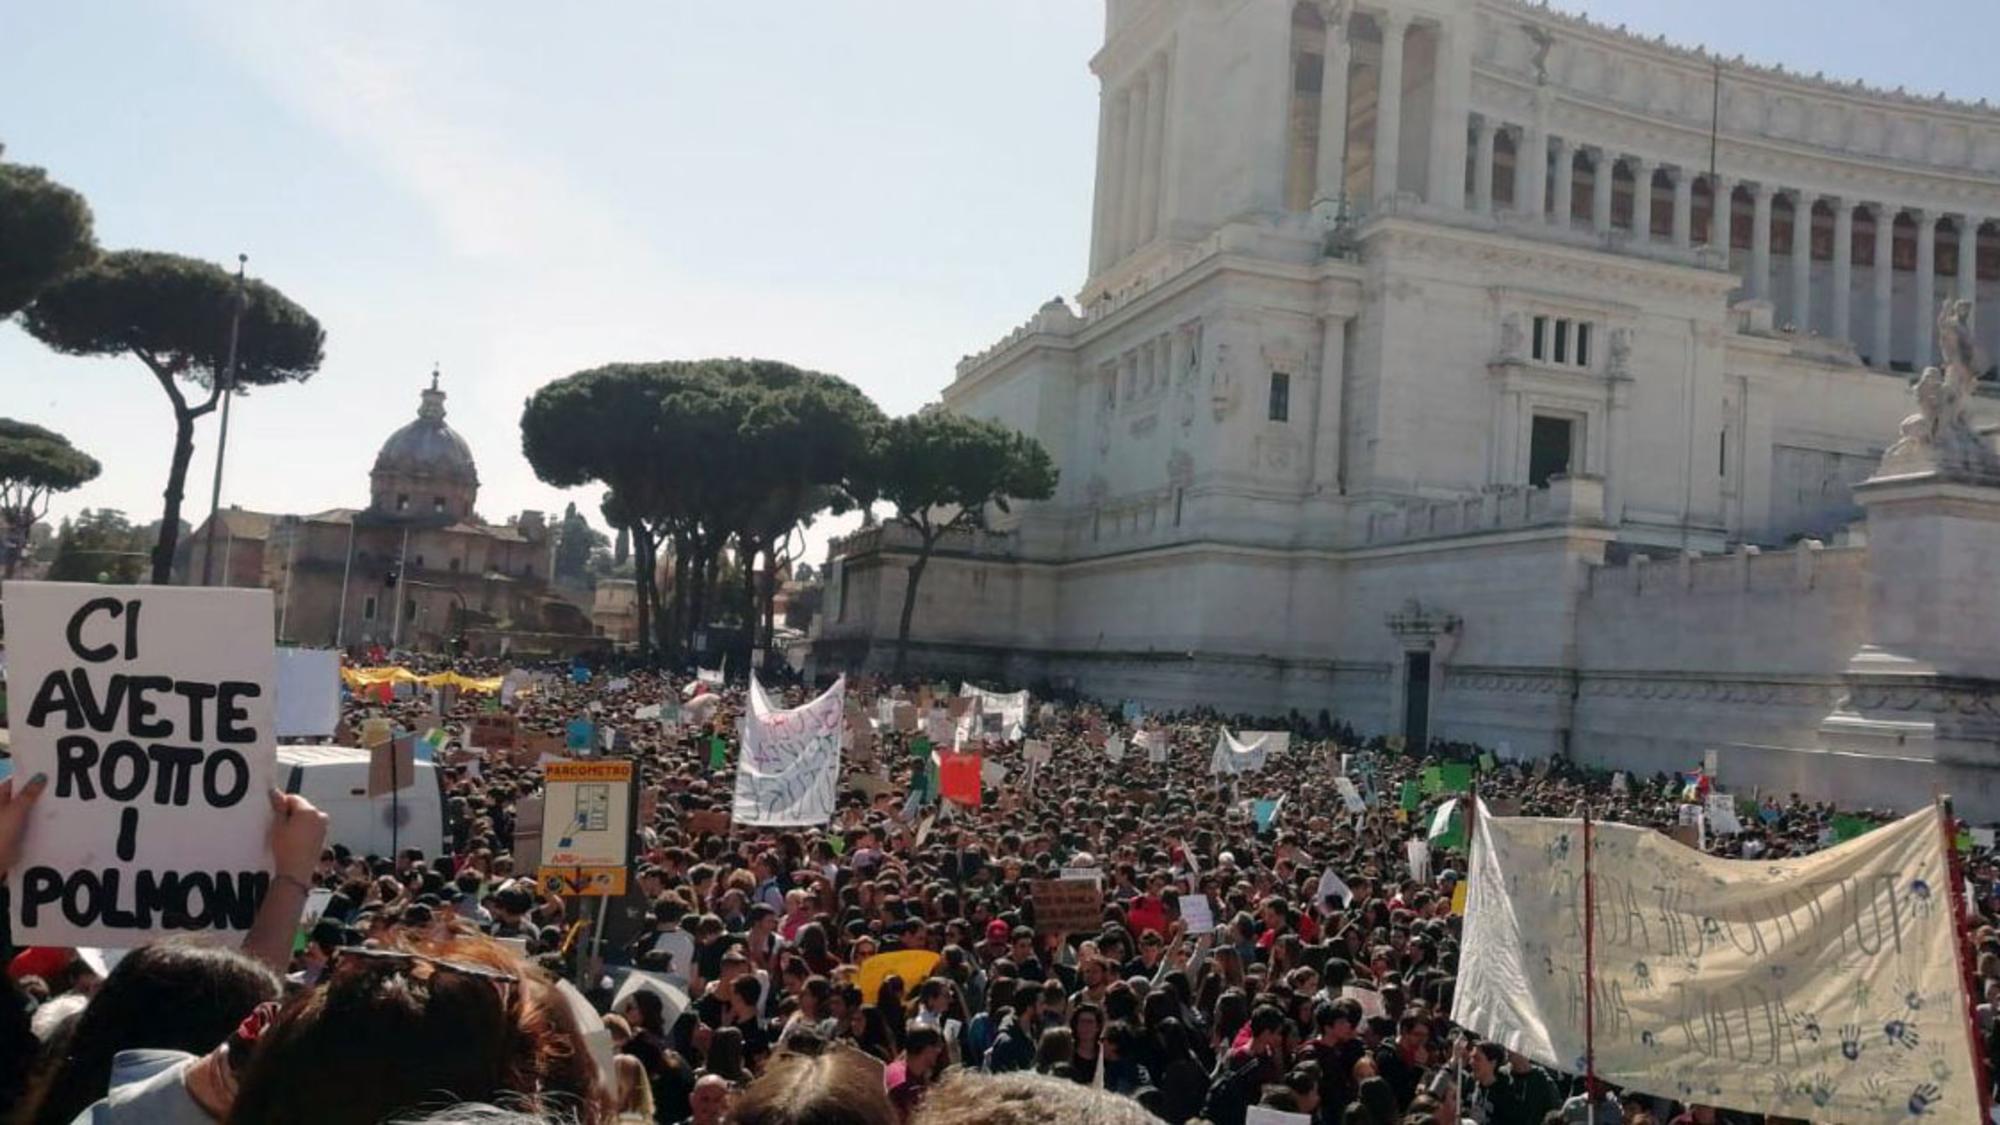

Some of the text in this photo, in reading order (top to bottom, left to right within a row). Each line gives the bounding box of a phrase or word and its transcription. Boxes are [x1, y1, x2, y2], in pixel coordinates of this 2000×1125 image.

[66, 597, 142, 662] CI
[26, 667, 261, 743] AVETE
[55, 735, 249, 808] ROTTO
[546, 765, 630, 777] PARCOMETRO
[116, 806, 139, 862] I
[21, 865, 270, 930] POLMONI
